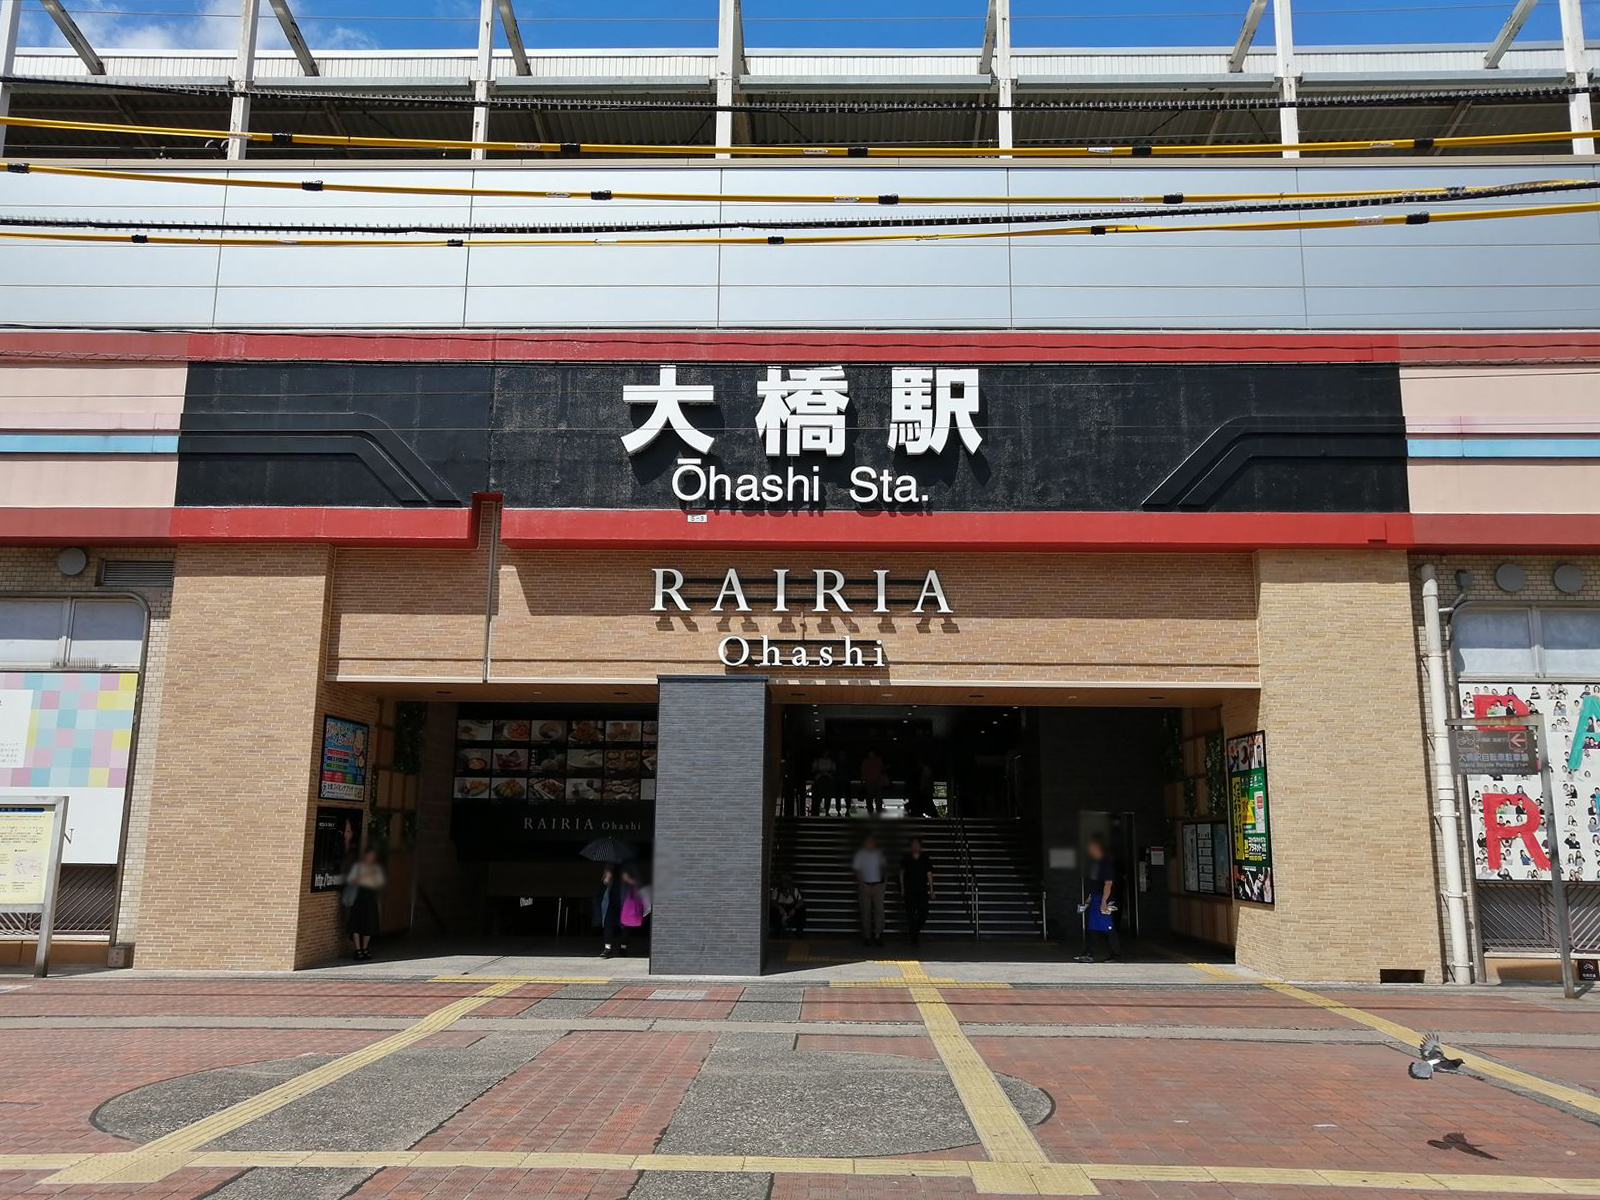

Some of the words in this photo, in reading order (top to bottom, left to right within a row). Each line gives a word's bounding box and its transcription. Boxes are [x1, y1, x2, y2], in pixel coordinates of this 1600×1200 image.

[620, 365, 983, 456] 大橋駅
[672, 458, 820, 501] Ōhashi
[850, 466, 929, 502] Sta.
[650, 568, 954, 613] RAIRIA
[717, 635, 886, 667] Ohashi
[523, 817, 594, 830] RAIRIA
[601, 820, 641, 830] Ohashi
